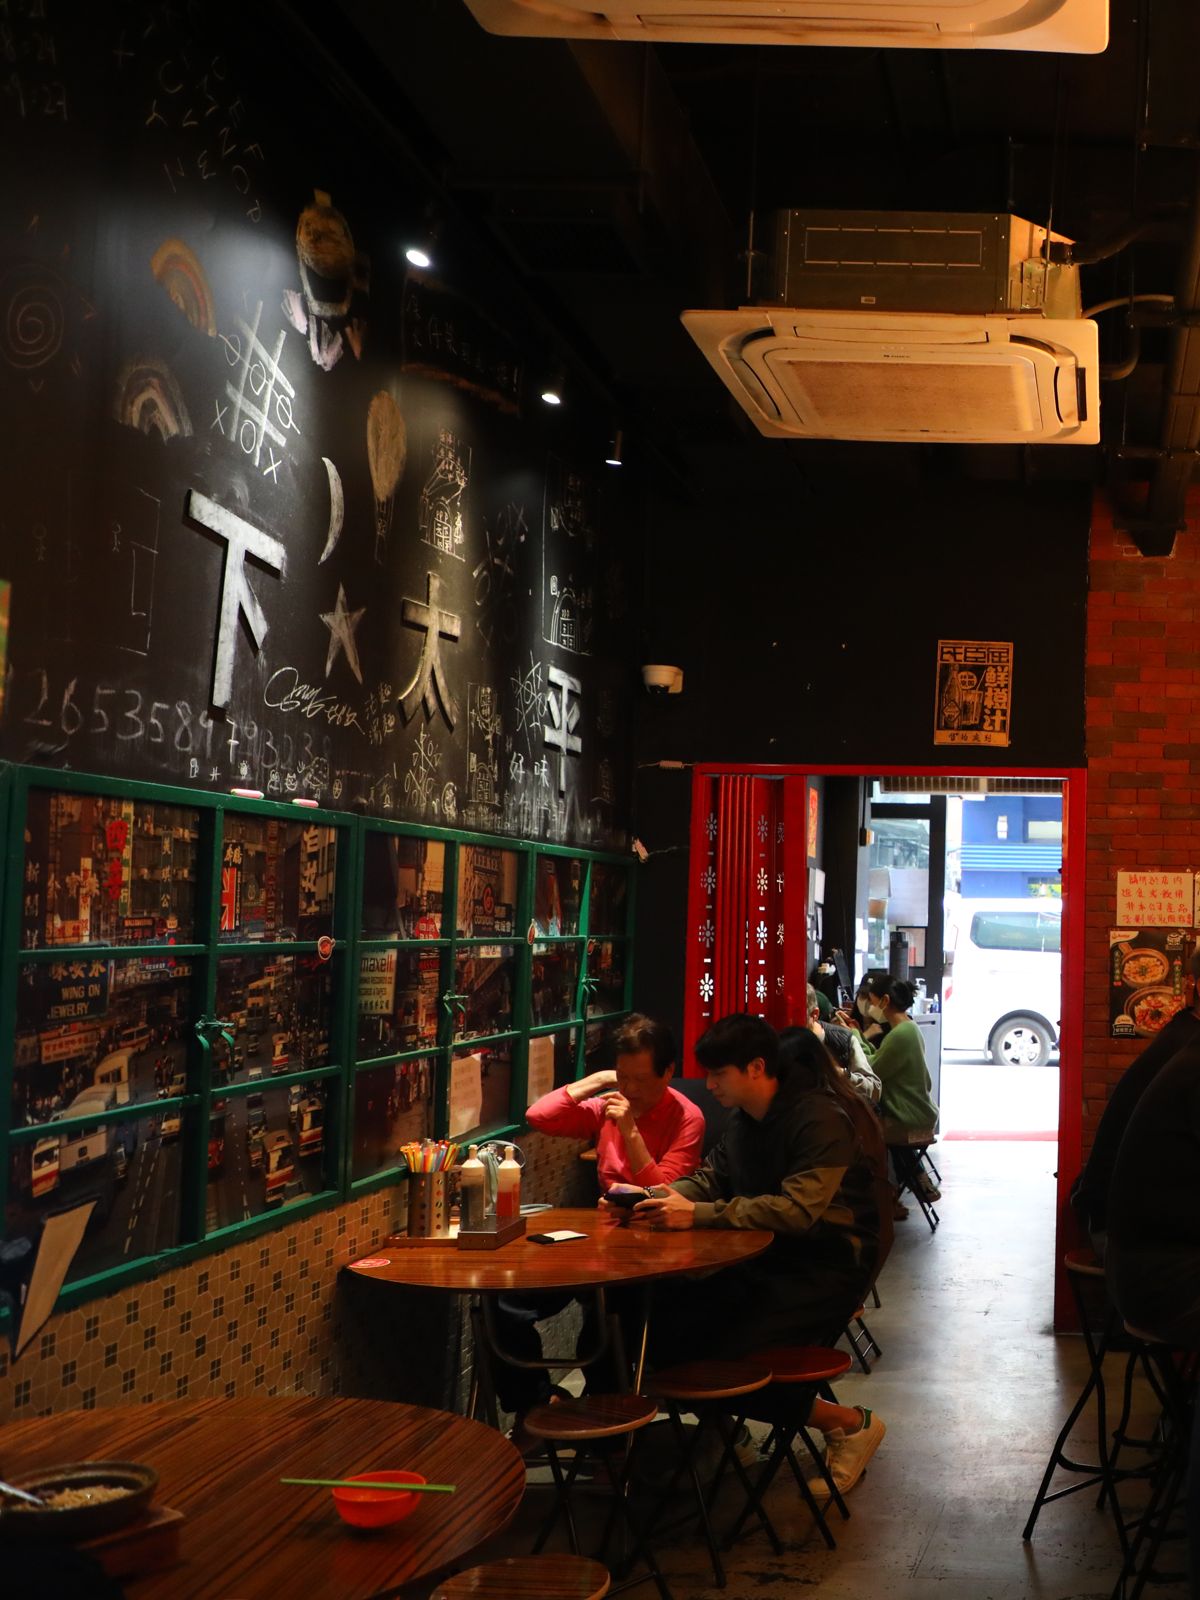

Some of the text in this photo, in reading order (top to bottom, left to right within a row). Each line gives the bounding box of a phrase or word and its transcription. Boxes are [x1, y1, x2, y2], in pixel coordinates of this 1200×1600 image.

[509, 752, 550, 787] 好味
[61, 984, 101, 1000] WING ON
[48, 1002, 90, 1018] JEWELRY
